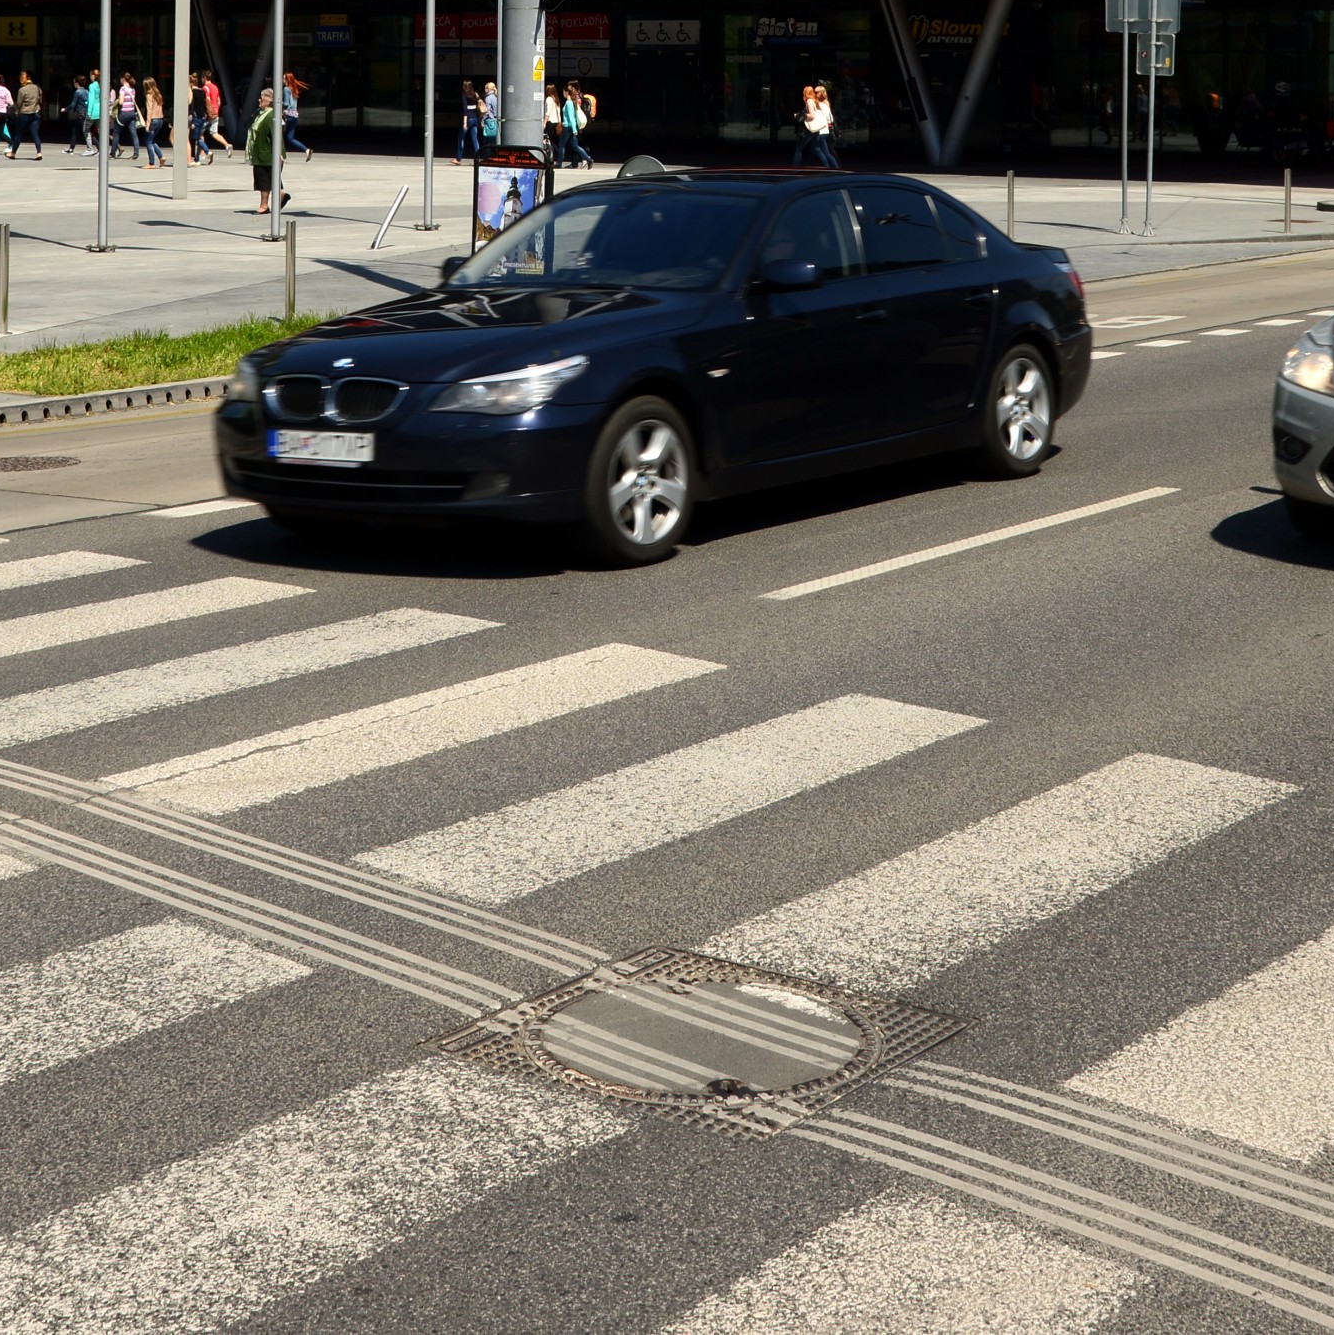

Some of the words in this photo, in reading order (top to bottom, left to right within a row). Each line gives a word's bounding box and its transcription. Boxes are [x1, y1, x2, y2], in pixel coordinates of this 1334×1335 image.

[317, 32, 351, 42] TRAFIKA
[443, 26, 457, 39] 4
[597, 27, 604, 39] 1
